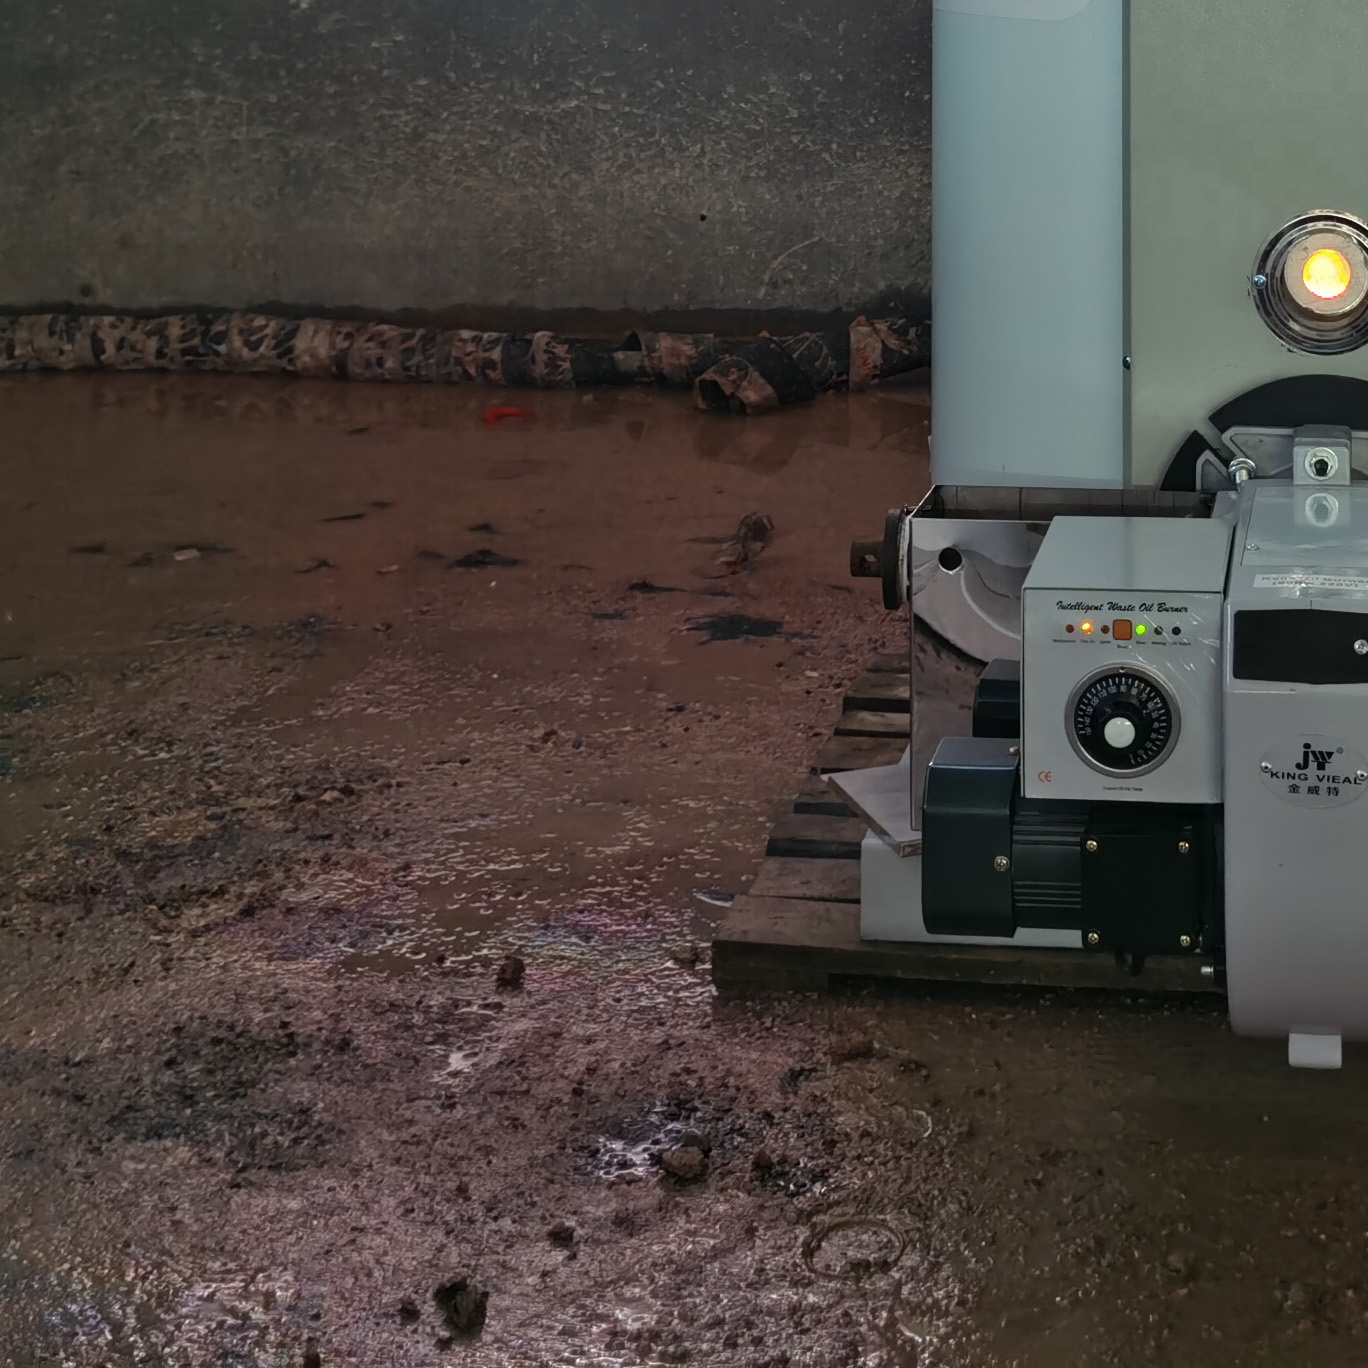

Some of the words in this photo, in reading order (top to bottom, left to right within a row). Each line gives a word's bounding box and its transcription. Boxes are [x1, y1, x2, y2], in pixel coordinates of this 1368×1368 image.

[1056, 601, 1102, 613] Intelligent
[1107, 602, 1136, 612] Waste
[1139, 603, 1154, 612] Oil
[1157, 602, 1188, 613] Burner
[1270, 771, 1308, 781] KING
[1288, 784, 1339, 796] 金威特
